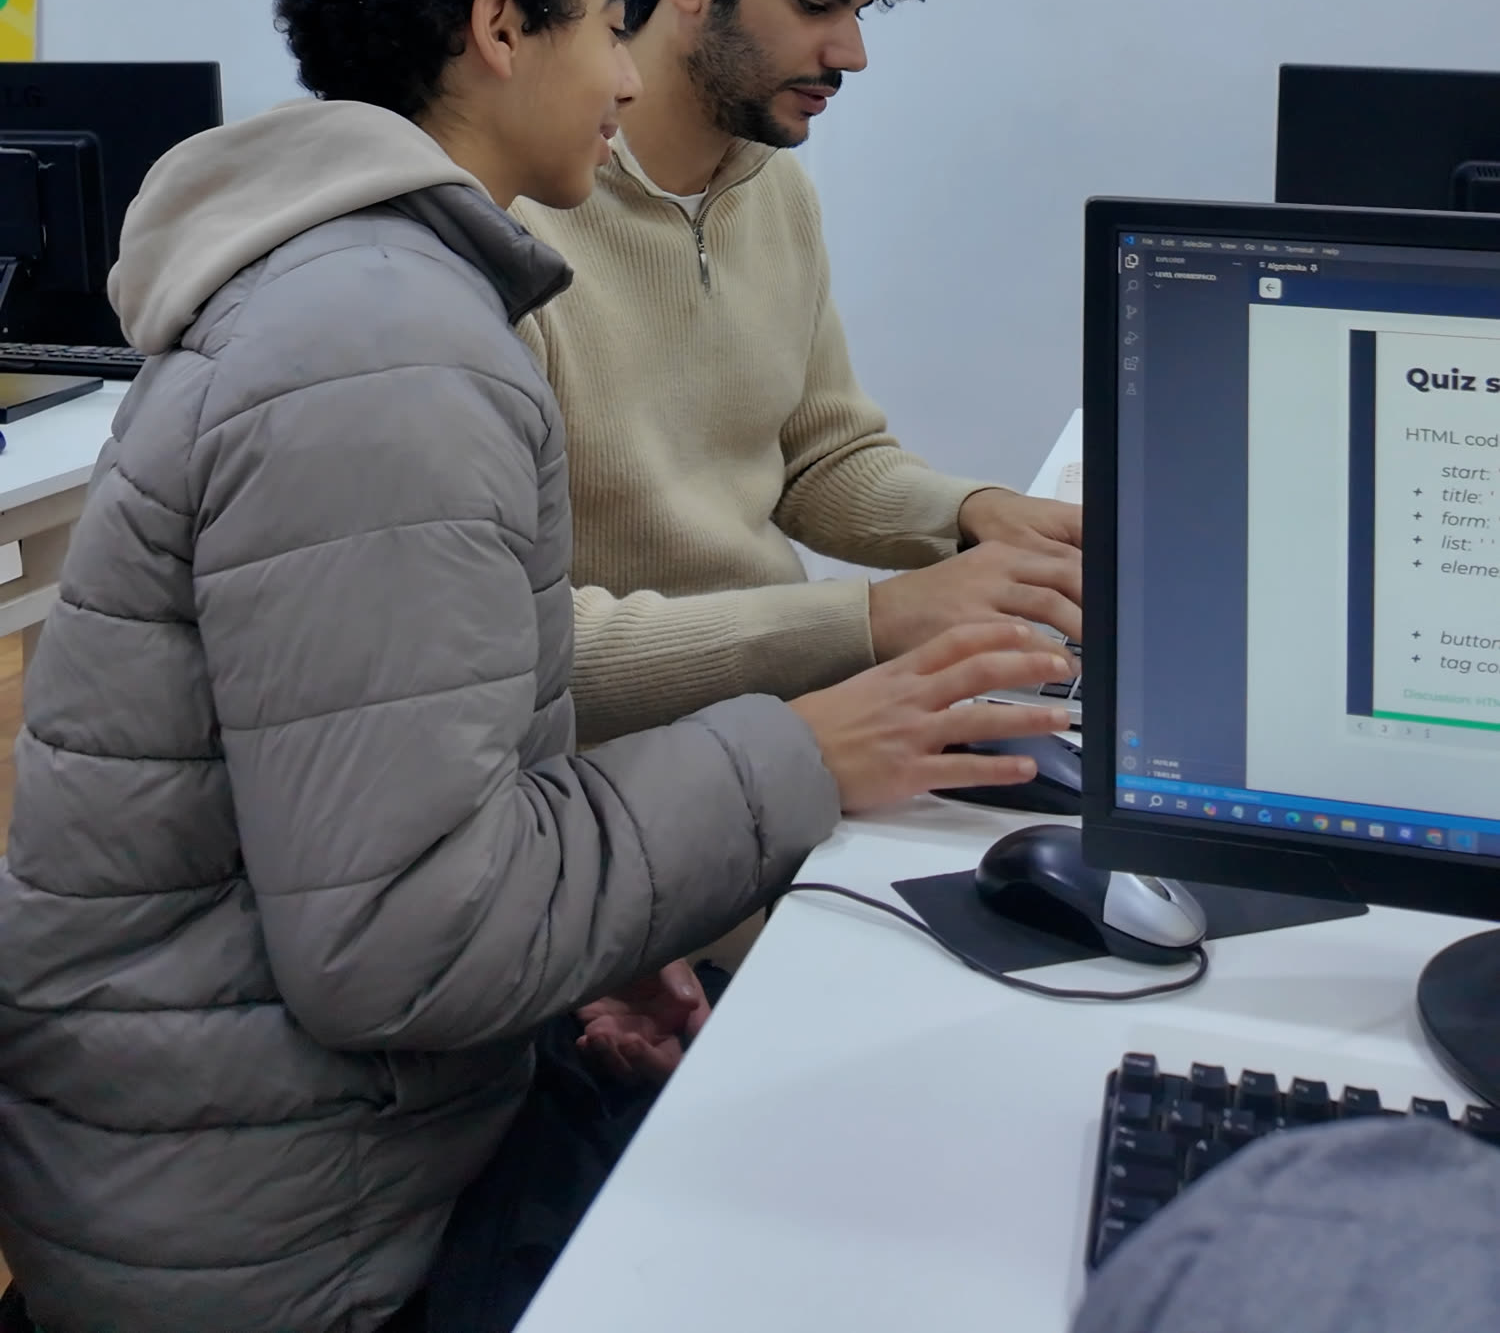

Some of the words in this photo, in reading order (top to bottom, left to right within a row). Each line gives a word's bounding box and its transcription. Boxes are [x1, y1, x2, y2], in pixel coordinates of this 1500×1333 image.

[1406, 367, 1477, 393] Quiz
[1405, 427, 1461, 445] HTML
[1464, 433, 1499, 448] cod
[1441, 465, 1490, 481] start:
[1442, 488, 1483, 505] title:
[1441, 511, 1490, 530] form:
[1441, 534, 1472, 552] list:
[1440, 656, 1472, 674] tag
